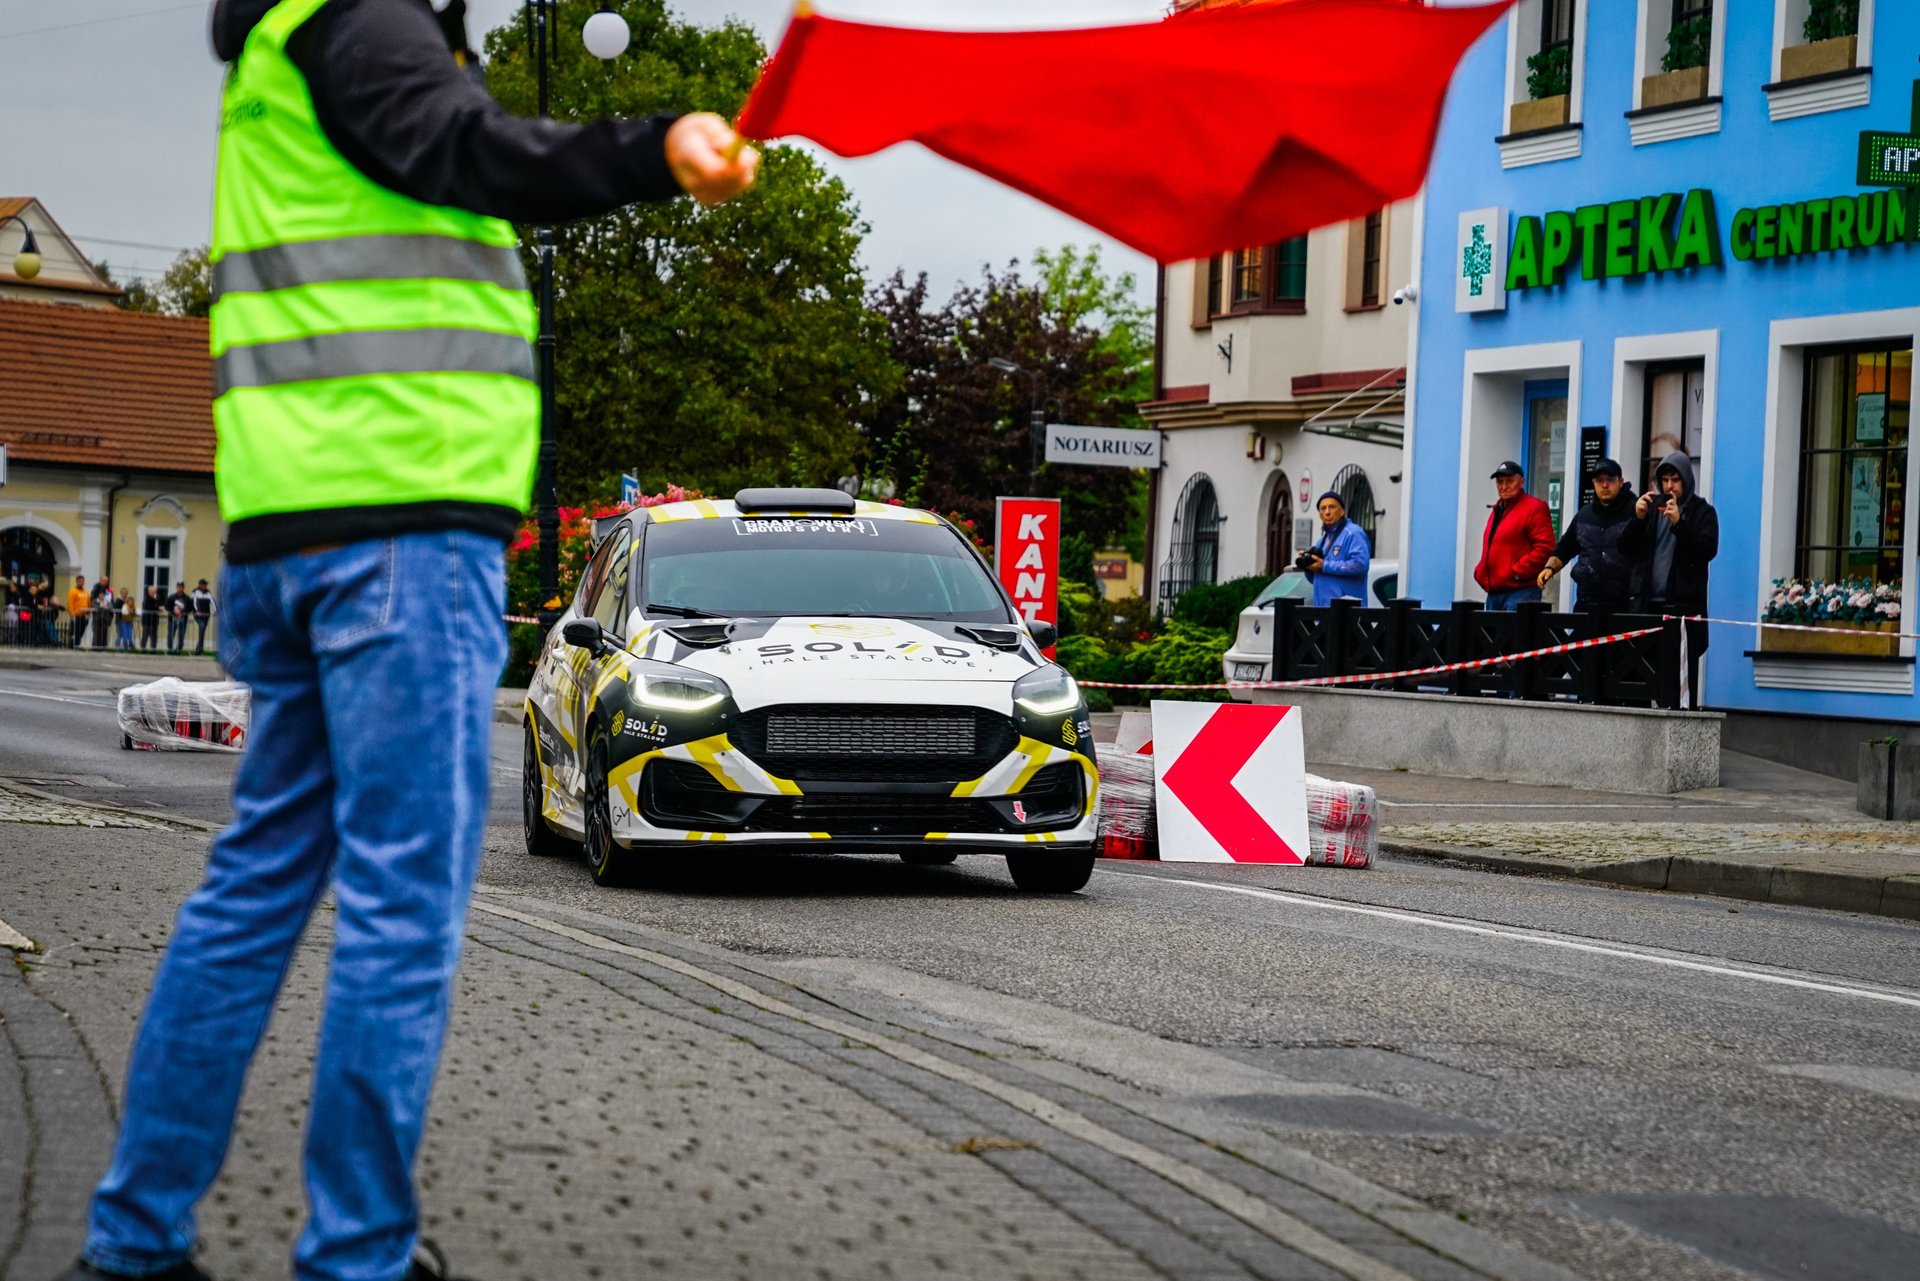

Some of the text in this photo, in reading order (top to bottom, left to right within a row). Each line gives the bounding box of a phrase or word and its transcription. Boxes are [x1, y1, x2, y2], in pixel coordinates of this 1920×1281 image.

[1884, 147, 1920, 172] AP
[1506, 189, 1721, 290] APTEKA
[1053, 435, 1154, 457] NOTARIUSZ
[762, 654, 978, 668] HALE STALOWE
